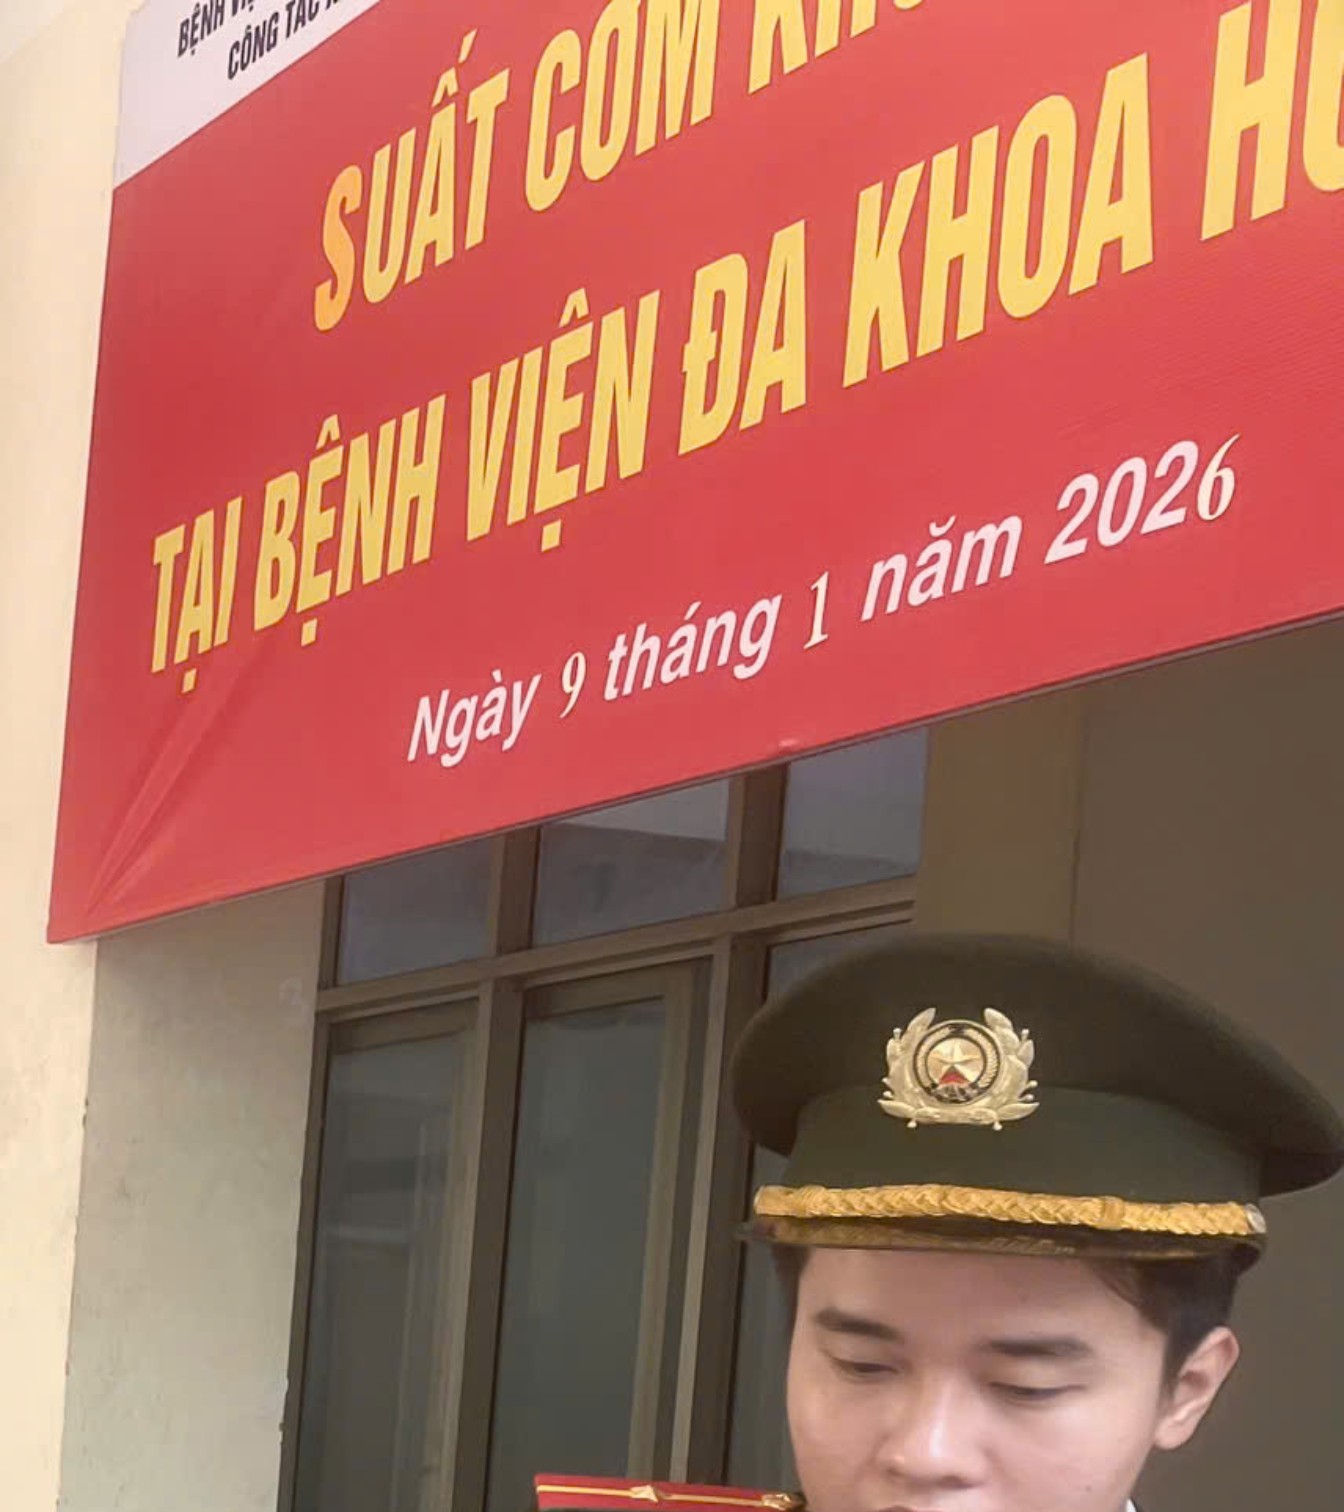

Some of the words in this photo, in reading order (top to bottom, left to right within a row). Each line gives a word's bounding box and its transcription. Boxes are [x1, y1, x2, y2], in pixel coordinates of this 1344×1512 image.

[227, 11, 280, 80] CÔNG
[314, 28, 510, 331] SUẤT
[150, 496, 243, 692] TẠI
[254, 394, 446, 647] BỆNH
[466, 288, 660, 552] VIỆN
[678, 219, 806, 455] ĐA
[842, 51, 1154, 388] KHOA
[407, 669, 542, 768] Ngày
[559, 651, 587, 718] 9
[604, 594, 783, 702] tháng
[803, 571, 829, 650] 1
[861, 515, 1023, 621] năm
[1044, 434, 1240, 564] 2026
